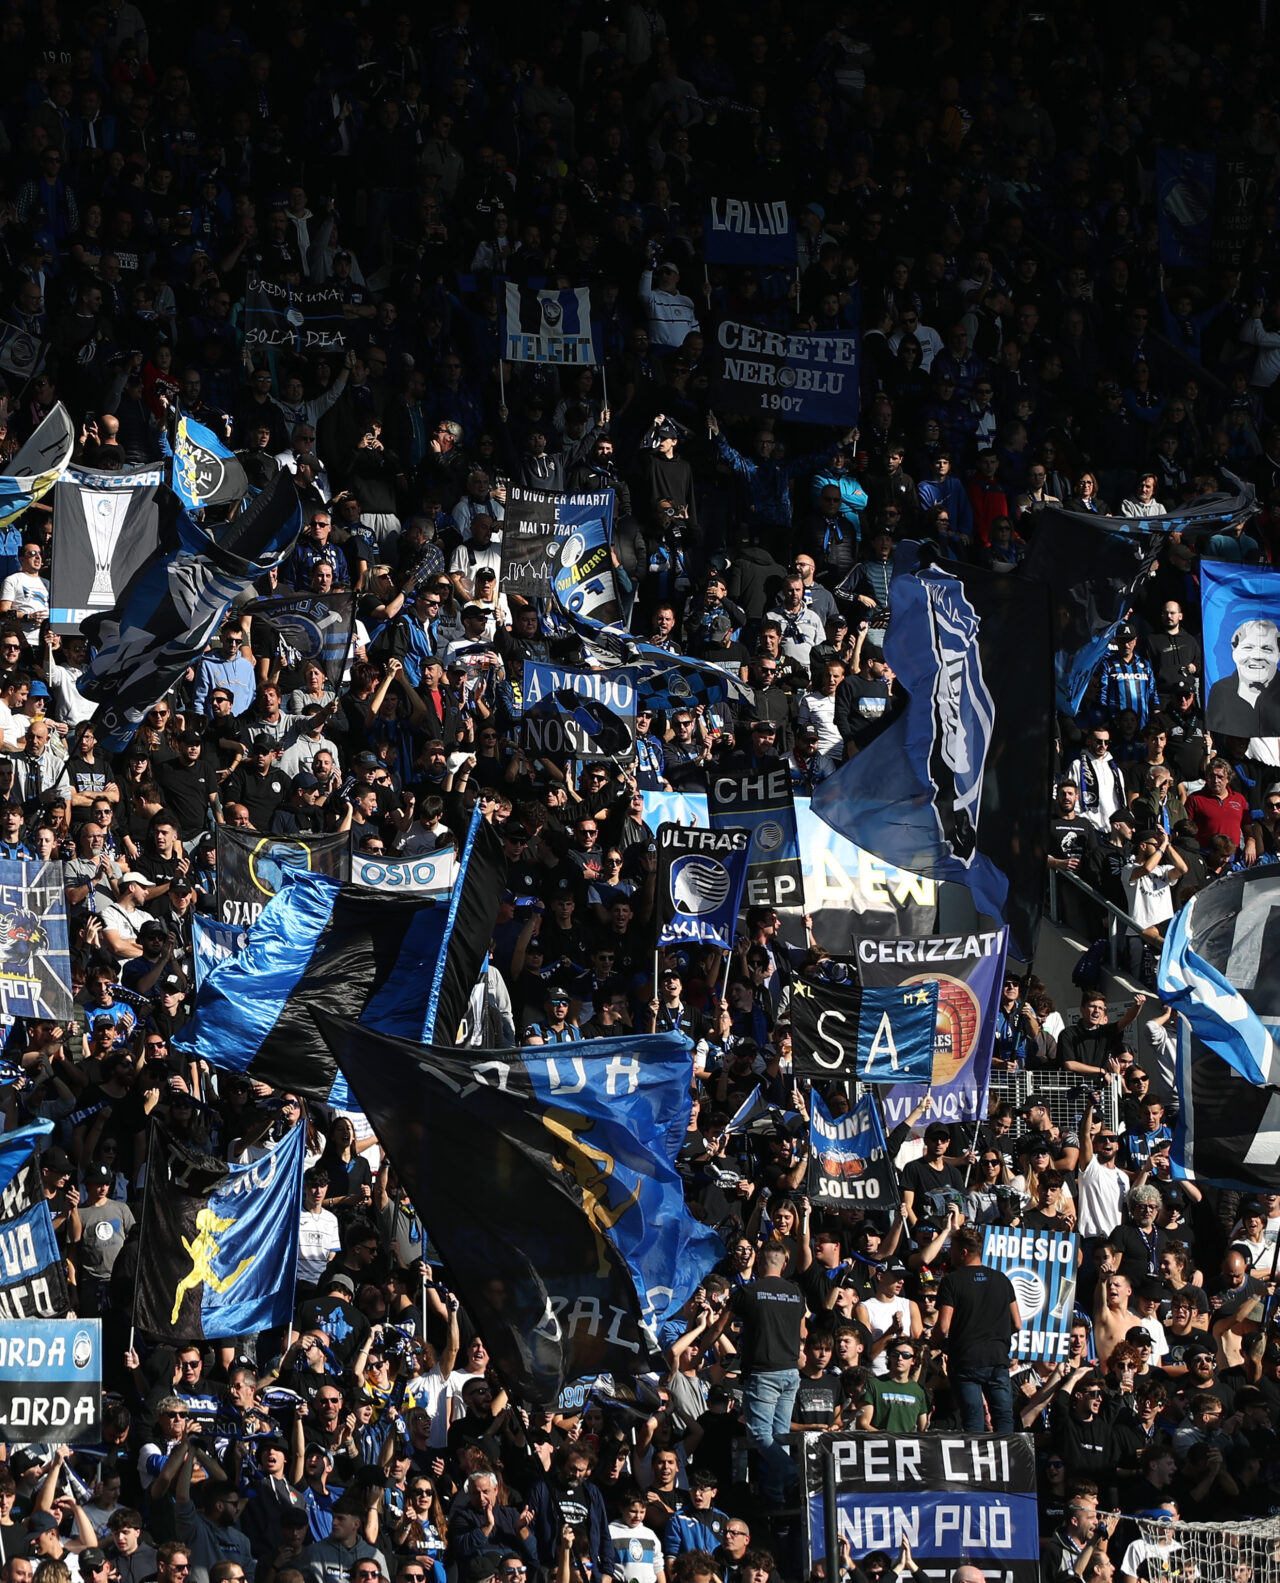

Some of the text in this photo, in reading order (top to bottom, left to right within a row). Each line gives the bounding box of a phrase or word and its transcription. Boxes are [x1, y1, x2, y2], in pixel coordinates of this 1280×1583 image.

[711, 197, 789, 235] LALLIO
[248, 280, 287, 299] CREDO
[289, 291, 304, 303] IN
[245, 328, 347, 347] SOLA DEA
[718, 321, 856, 365] CERETE
[760, 393, 804, 412] 1907
[512, 487, 611, 506] IO VIVO PER AMARTI
[554, 508, 561, 520] E
[519, 521, 537, 534] MAI
[553, 524, 583, 536] TRAD
[526, 668, 634, 709] A MODO
[525, 718, 634, 756] NOST
[715, 769, 789, 804] CHE
[661, 829, 748, 851] ULTRAS
[361, 862, 435, 886] OSIO
[858, 932, 1004, 963] CERIZZATI
[883, 1089, 989, 1122] VUNQU
[819, 1177, 880, 1199] SOLTO
[985, 1233, 1074, 1264] ARDESIO
[1010, 1331, 1070, 1356] SENTE
[832, 1440, 1010, 1483] PER CHI
[837, 1499, 1013, 1550] NON PUÒ
